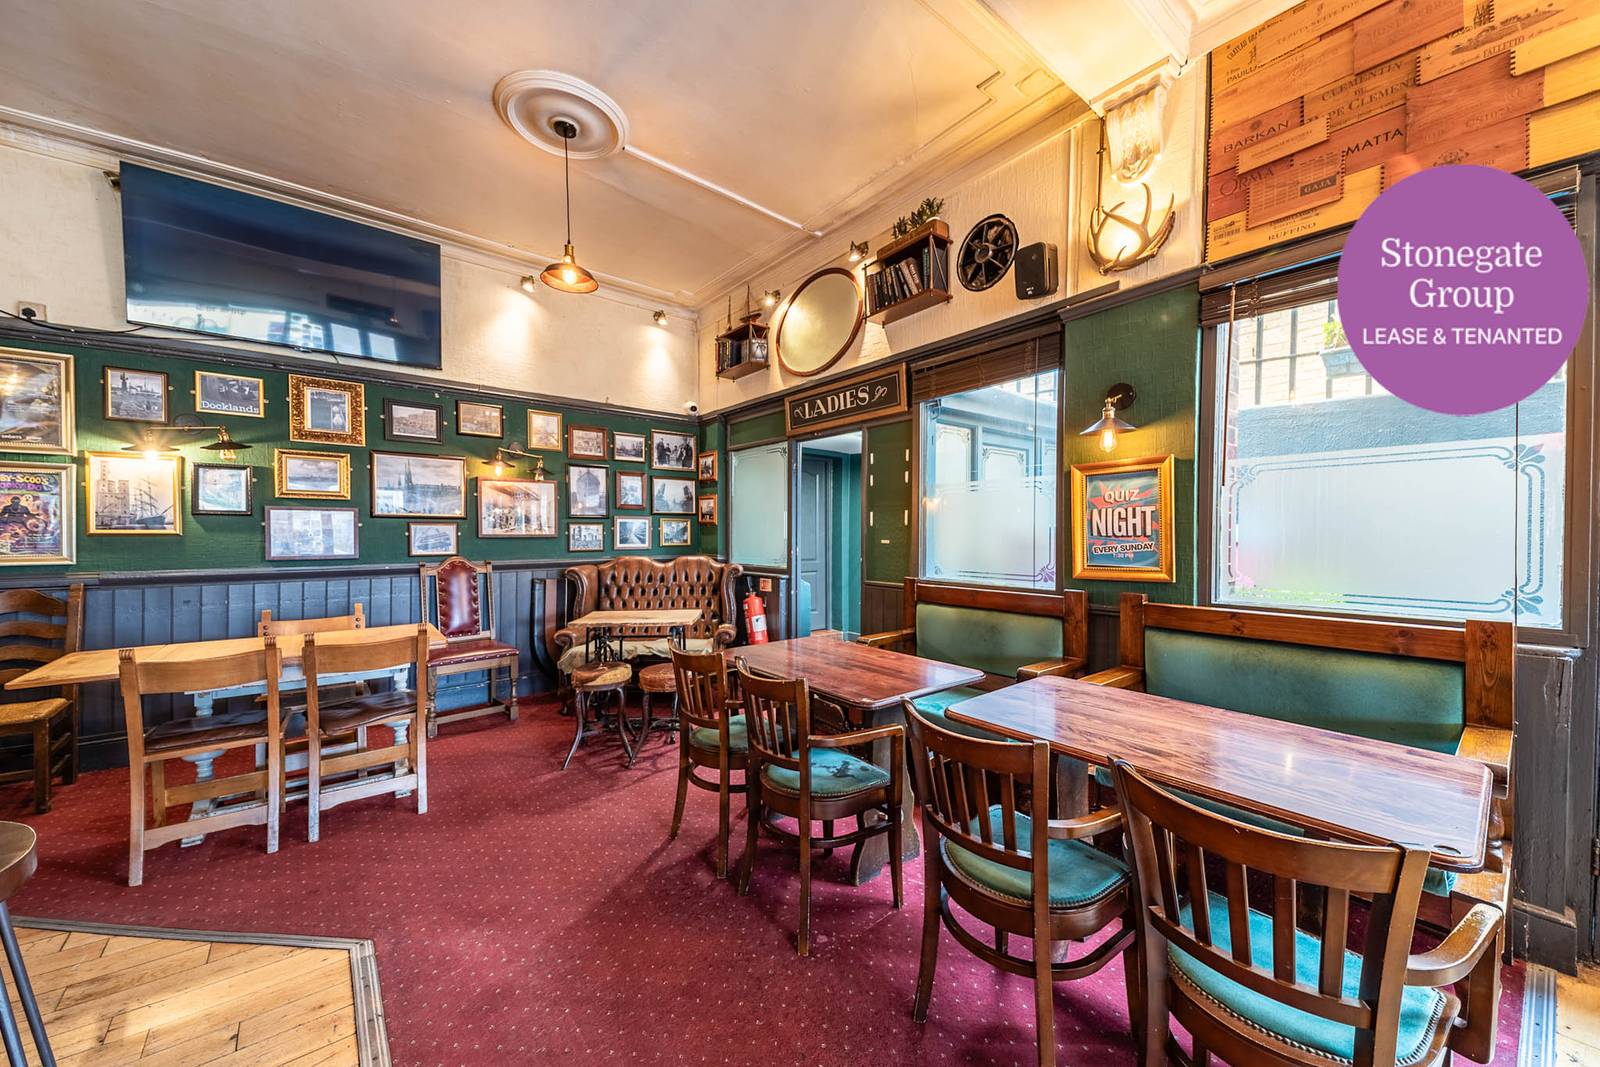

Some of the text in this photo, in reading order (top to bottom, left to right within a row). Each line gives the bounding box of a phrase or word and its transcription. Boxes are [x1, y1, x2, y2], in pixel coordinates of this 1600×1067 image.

[1223, 120, 1289, 153] BARKAN
[1345, 127, 1403, 157] MATTA
[1268, 222, 1317, 241] RUFFINO
[202, 400, 259, 414] Docklands
[804, 385, 870, 419] LADIES
[1104, 489, 1140, 503] QUIZ
[1091, 505, 1156, 537] NIGHT
[1093, 542, 1154, 554] EVERY SUNDAY
